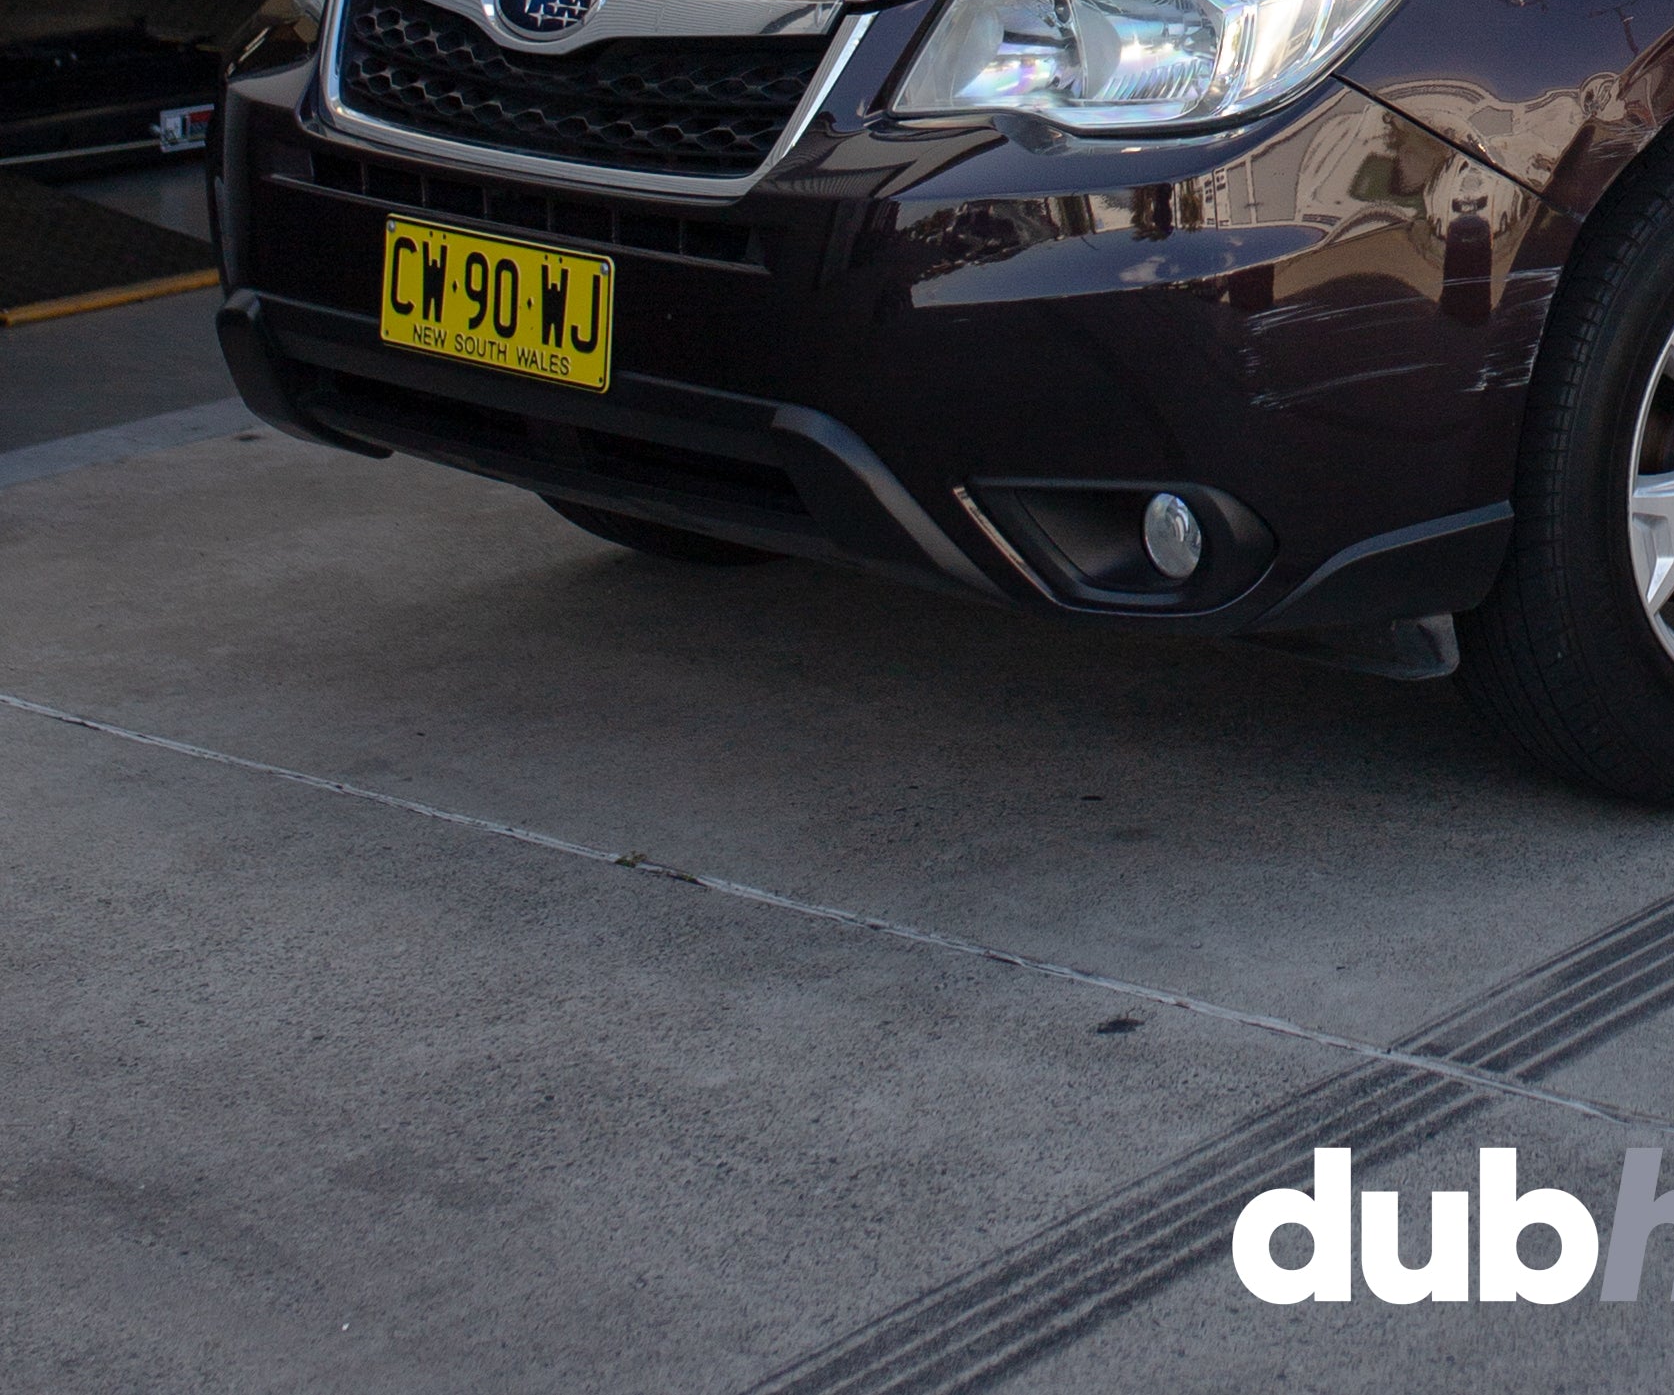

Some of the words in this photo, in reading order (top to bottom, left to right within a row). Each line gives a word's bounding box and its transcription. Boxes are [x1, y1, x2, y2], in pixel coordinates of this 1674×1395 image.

[413, 324, 448, 348] NEW
[454, 332, 508, 363] SOUTH
[516, 344, 571, 376] WALES
